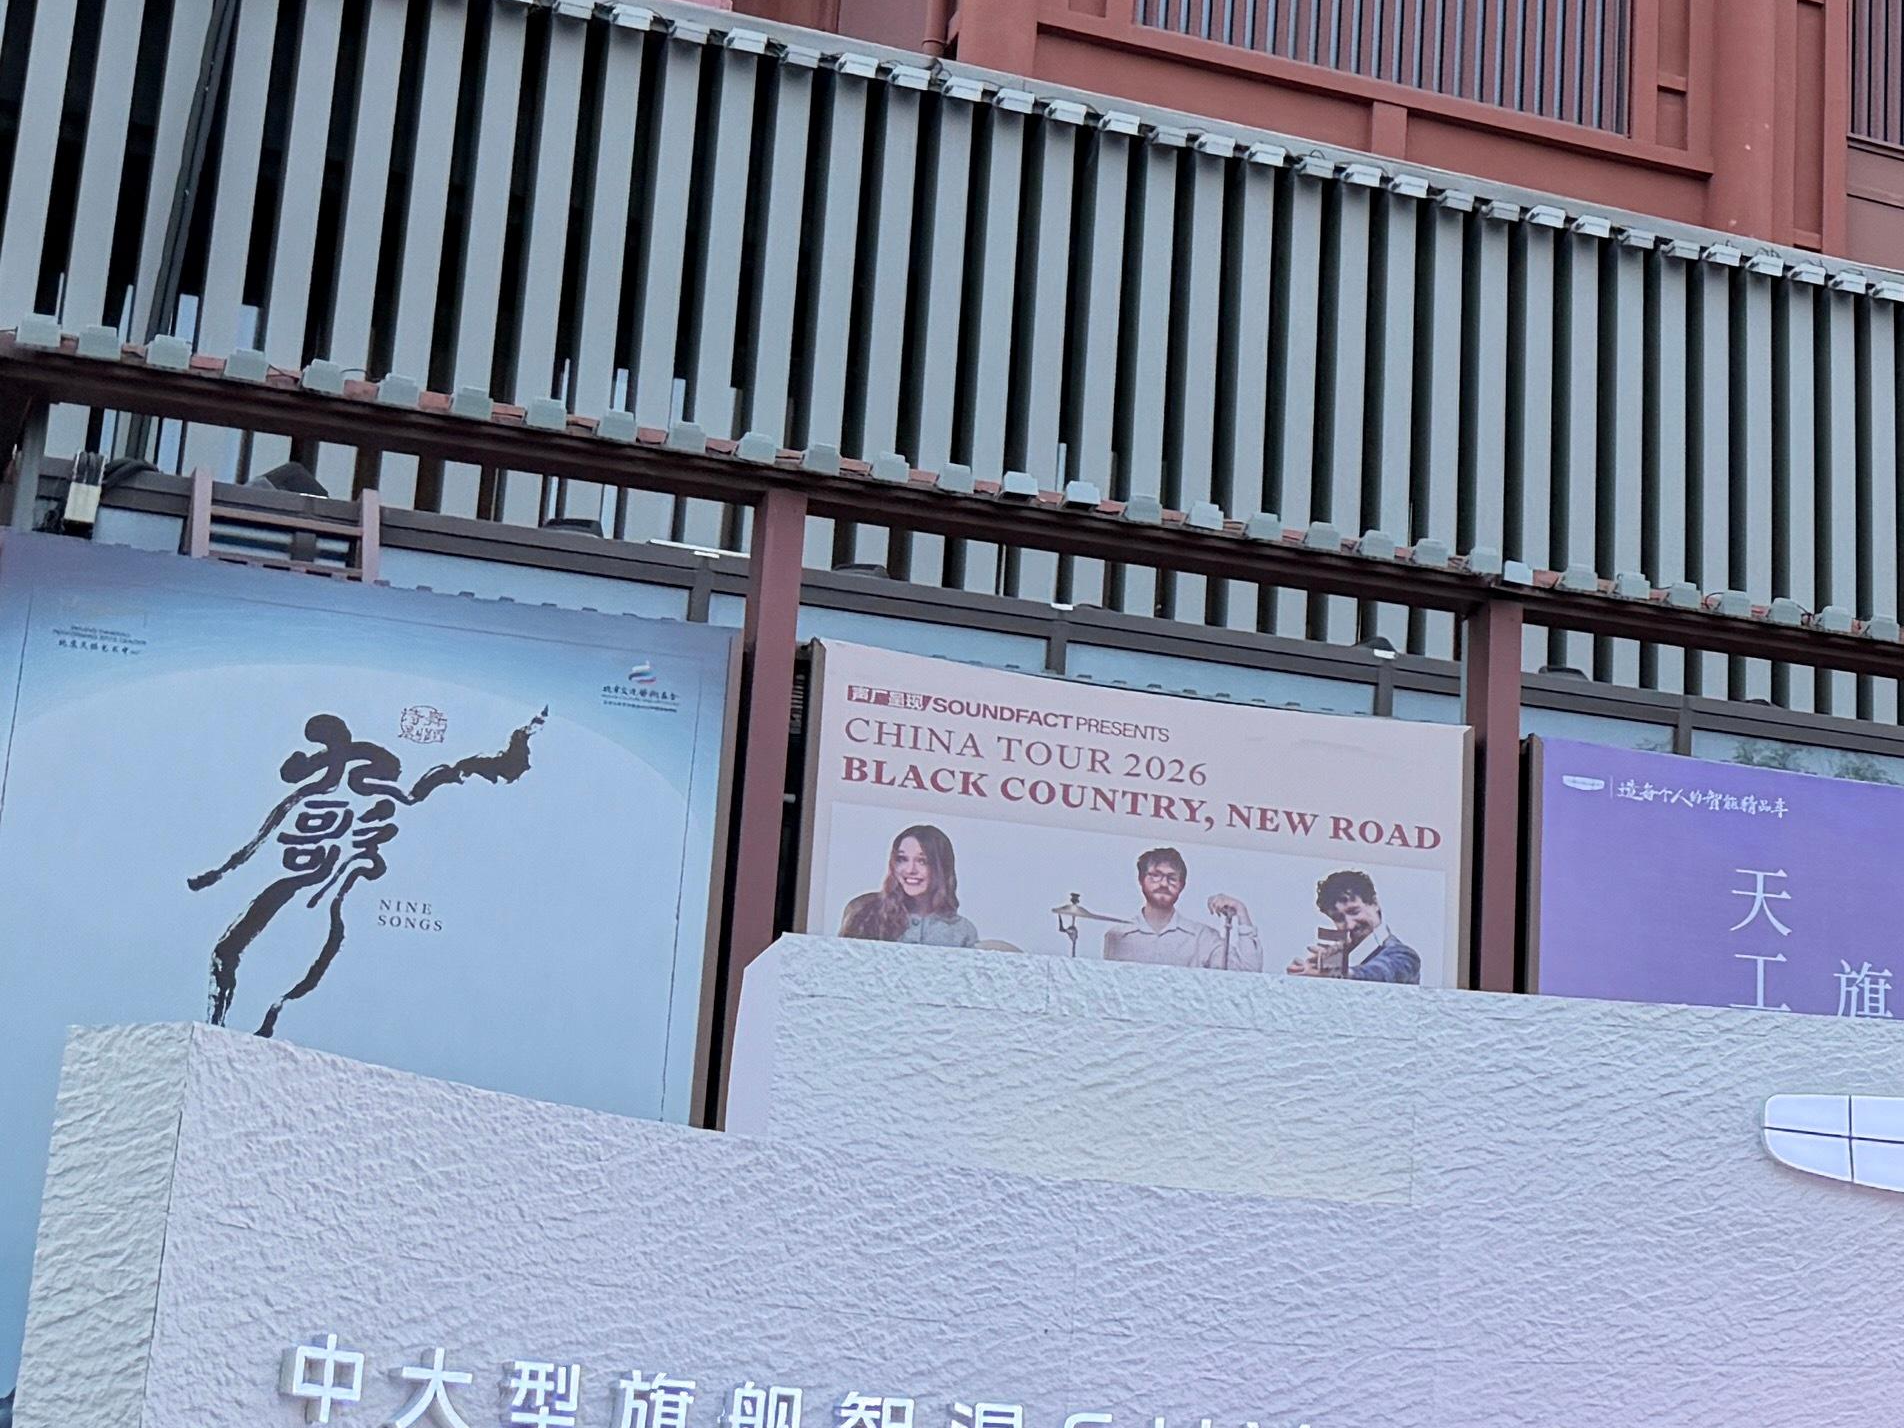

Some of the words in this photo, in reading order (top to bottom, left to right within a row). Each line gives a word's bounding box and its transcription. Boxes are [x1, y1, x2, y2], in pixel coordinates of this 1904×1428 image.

[931, 697, 1074, 730] SOUNDFACT
[1075, 716, 1170, 743] PRESENTS
[843, 716, 983, 760] CHINA
[996, 735, 1113, 774] TOUR
[1123, 752, 1208, 787] 2026
[840, 755, 989, 799] BLACK
[1000, 777, 1216, 832] COUNTRY,
[1226, 803, 1319, 838] NEW
[1329, 816, 1442, 852] ROAD
[377, 914, 444, 932] SONGS
[379, 898, 433, 916] NINE
